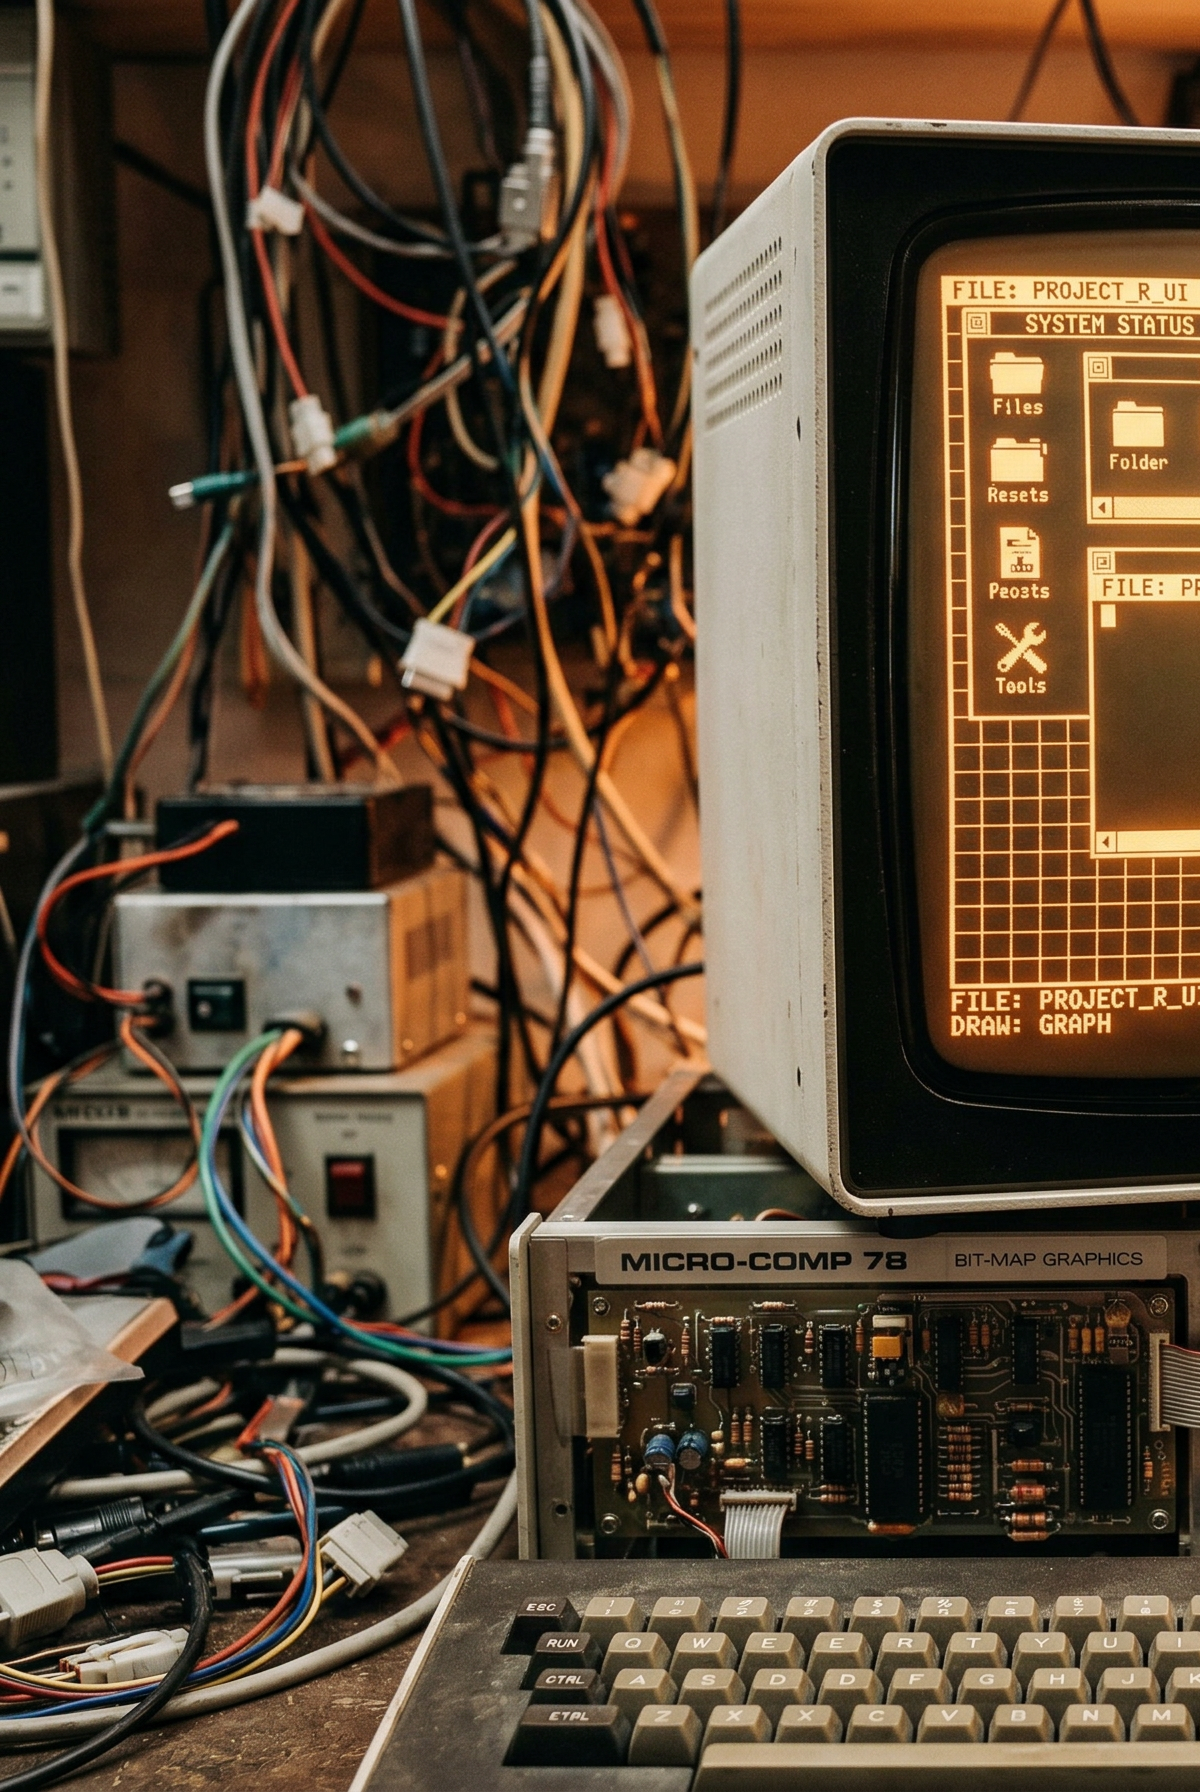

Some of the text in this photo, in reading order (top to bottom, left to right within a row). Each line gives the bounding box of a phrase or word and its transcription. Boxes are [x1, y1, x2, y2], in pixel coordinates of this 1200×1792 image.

[953, 280, 1188, 305] FILE: PROJECT_R_UI
[1025, 313, 1195, 336] SYSTEM STATUS
[993, 397, 1043, 415] Files
[1109, 453, 1169, 471] Folder
[987, 486, 1049, 503] Resets
[1102, 578, 1164, 597] FILE:
[995, 676, 1047, 694] Tools
[951, 991, 1020, 1012] FILE:
[950, 1012, 1112, 1037] DRAW: GRAPH
[621, 1251, 907, 1272] MICRO-COMP 78
[955, 1251, 1143, 1268] BIT-MAP GRAPHICS
[526, 1603, 556, 1612] ESC
[546, 1638, 579, 1648] RUN
[624, 1637, 642, 1649] Q
[693, 1637, 712, 1649] W
[761, 1637, 777, 1649] E
[829, 1637, 845, 1649] E
[897, 1637, 913, 1649] R
[966, 1637, 981, 1649] T
[1034, 1637, 1050, 1648] Y
[1103, 1637, 1118, 1649] U
[1177, 1637, 1182, 1648] I
[545, 1675, 584, 1685] CTRL
[629, 1674, 646, 1685] A
[701, 1674, 716, 1686] S
[769, 1673, 787, 1686] D
[839, 1673, 856, 1686] D
[908, 1673, 924, 1685] F
[979, 1673, 995, 1685] G
[1049, 1673, 1065, 1685] H
[1121, 1673, 1135, 1685] J
[654, 1710, 672, 1723] Z
[726, 1710, 743, 1722] X
[797, 1709, 814, 1721] X
[868, 1709, 885, 1722] C
[941, 1709, 959, 1722] V
[1010, 1709, 1026, 1722] B
[1082, 1709, 1099, 1721] N
[1152, 1709, 1171, 1721] M
